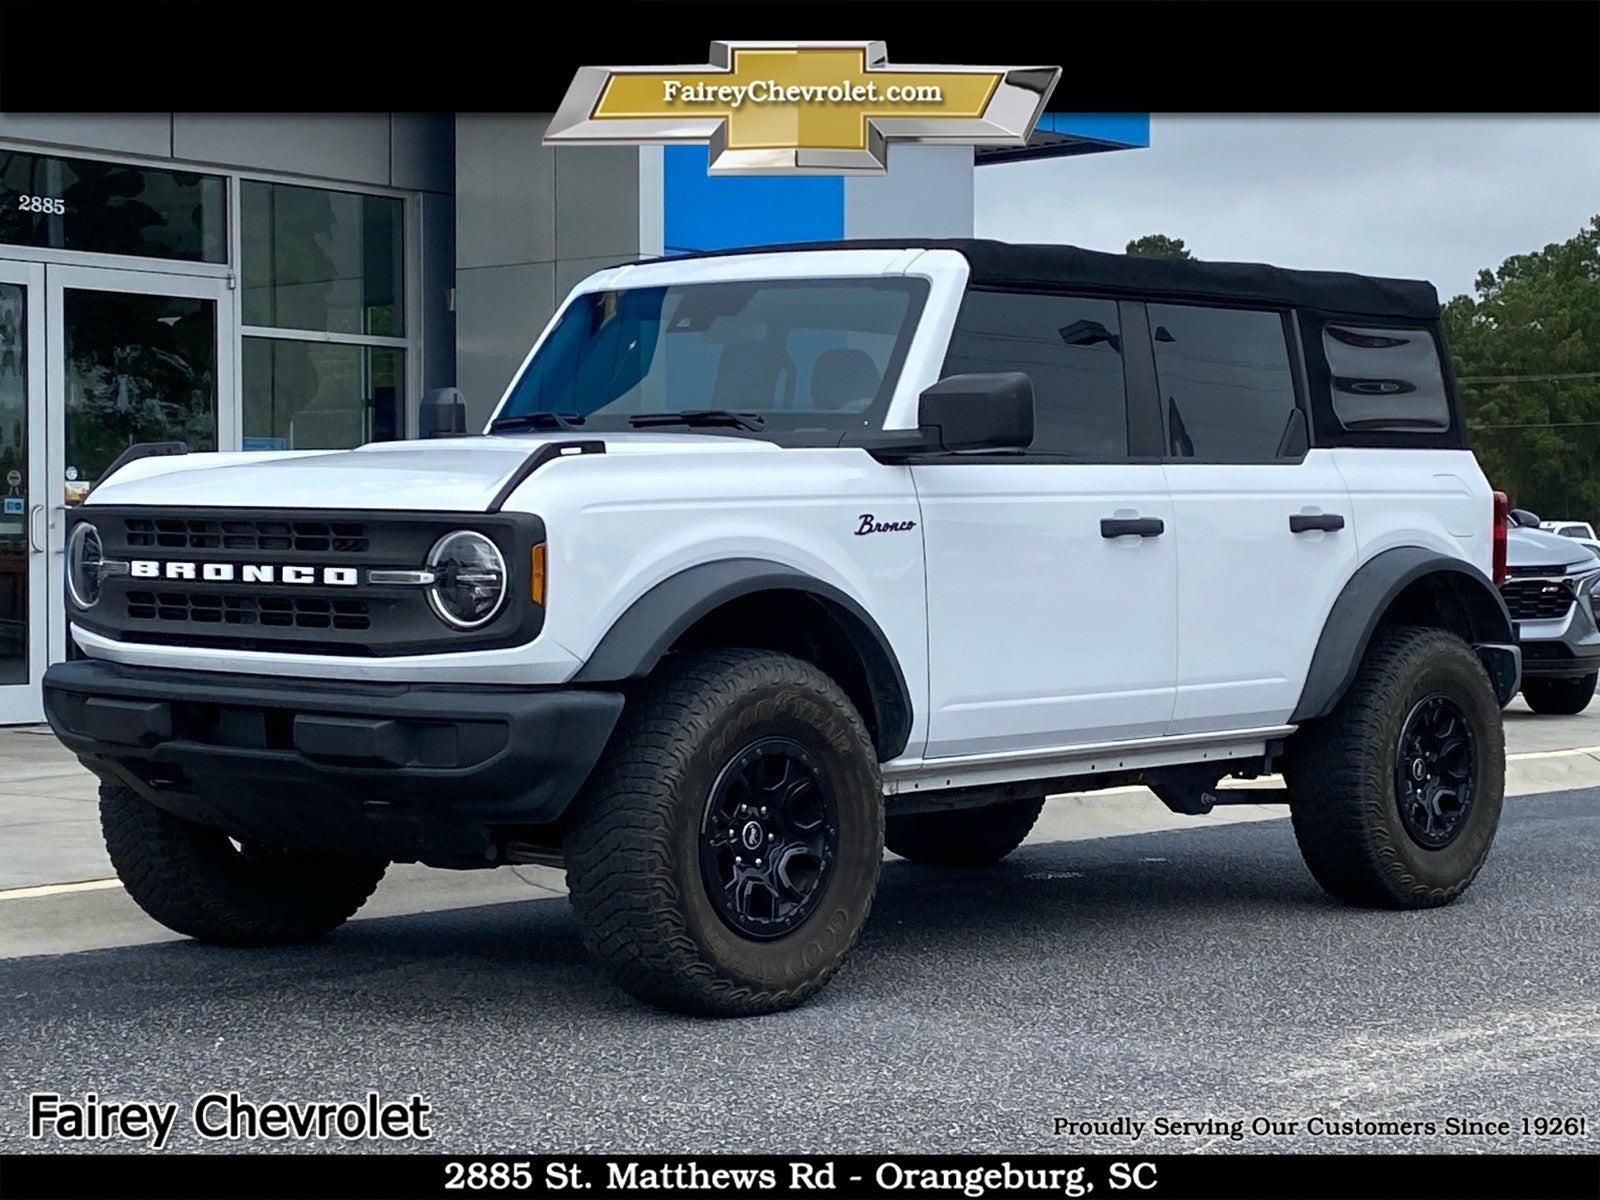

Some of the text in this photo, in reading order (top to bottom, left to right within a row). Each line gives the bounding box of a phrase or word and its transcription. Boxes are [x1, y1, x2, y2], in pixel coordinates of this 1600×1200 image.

[18, 194, 66, 215] 2885
[854, 513, 917, 536] Bronco
[131, 560, 358, 585] BRONCO
